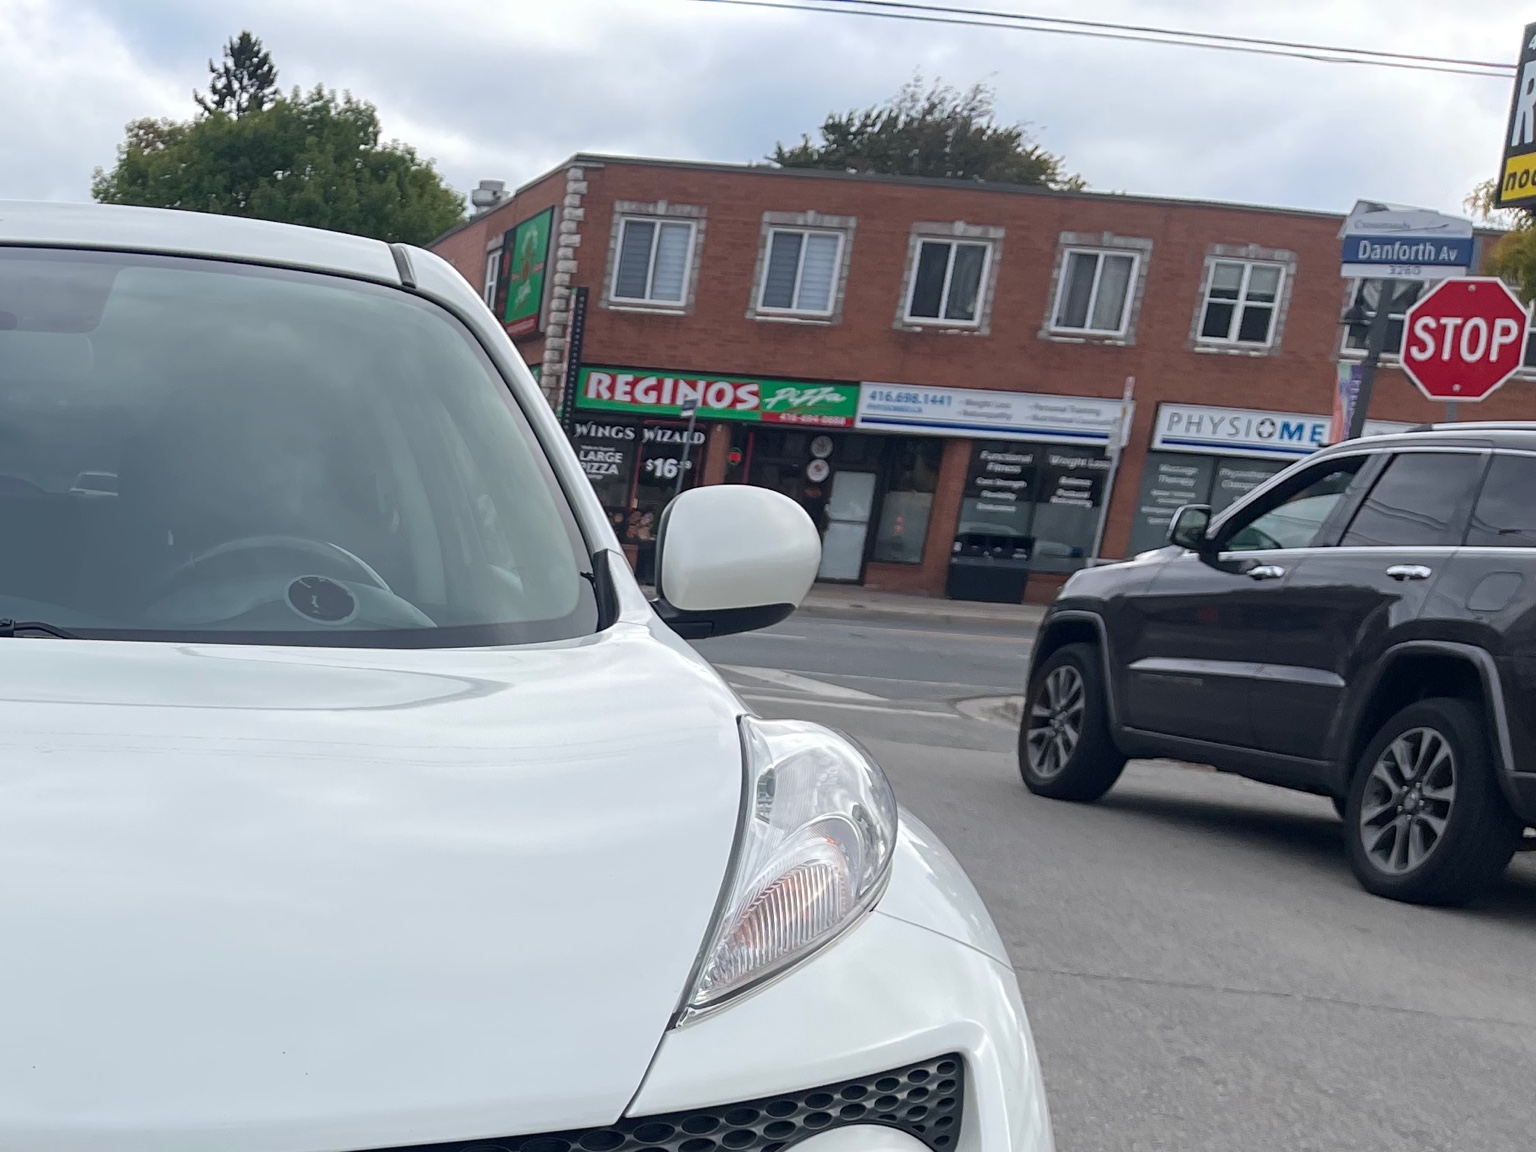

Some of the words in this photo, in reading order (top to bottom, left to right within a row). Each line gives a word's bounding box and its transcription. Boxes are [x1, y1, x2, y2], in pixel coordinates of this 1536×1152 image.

[1357, 240, 1436, 261] Danforth
[1439, 245, 1459, 261] Av
[1410, 316, 1519, 363] STOP
[587, 372, 760, 410] REGINOS
[574, 421, 635, 440] WINGS
[579, 451, 623, 463] LARGE
